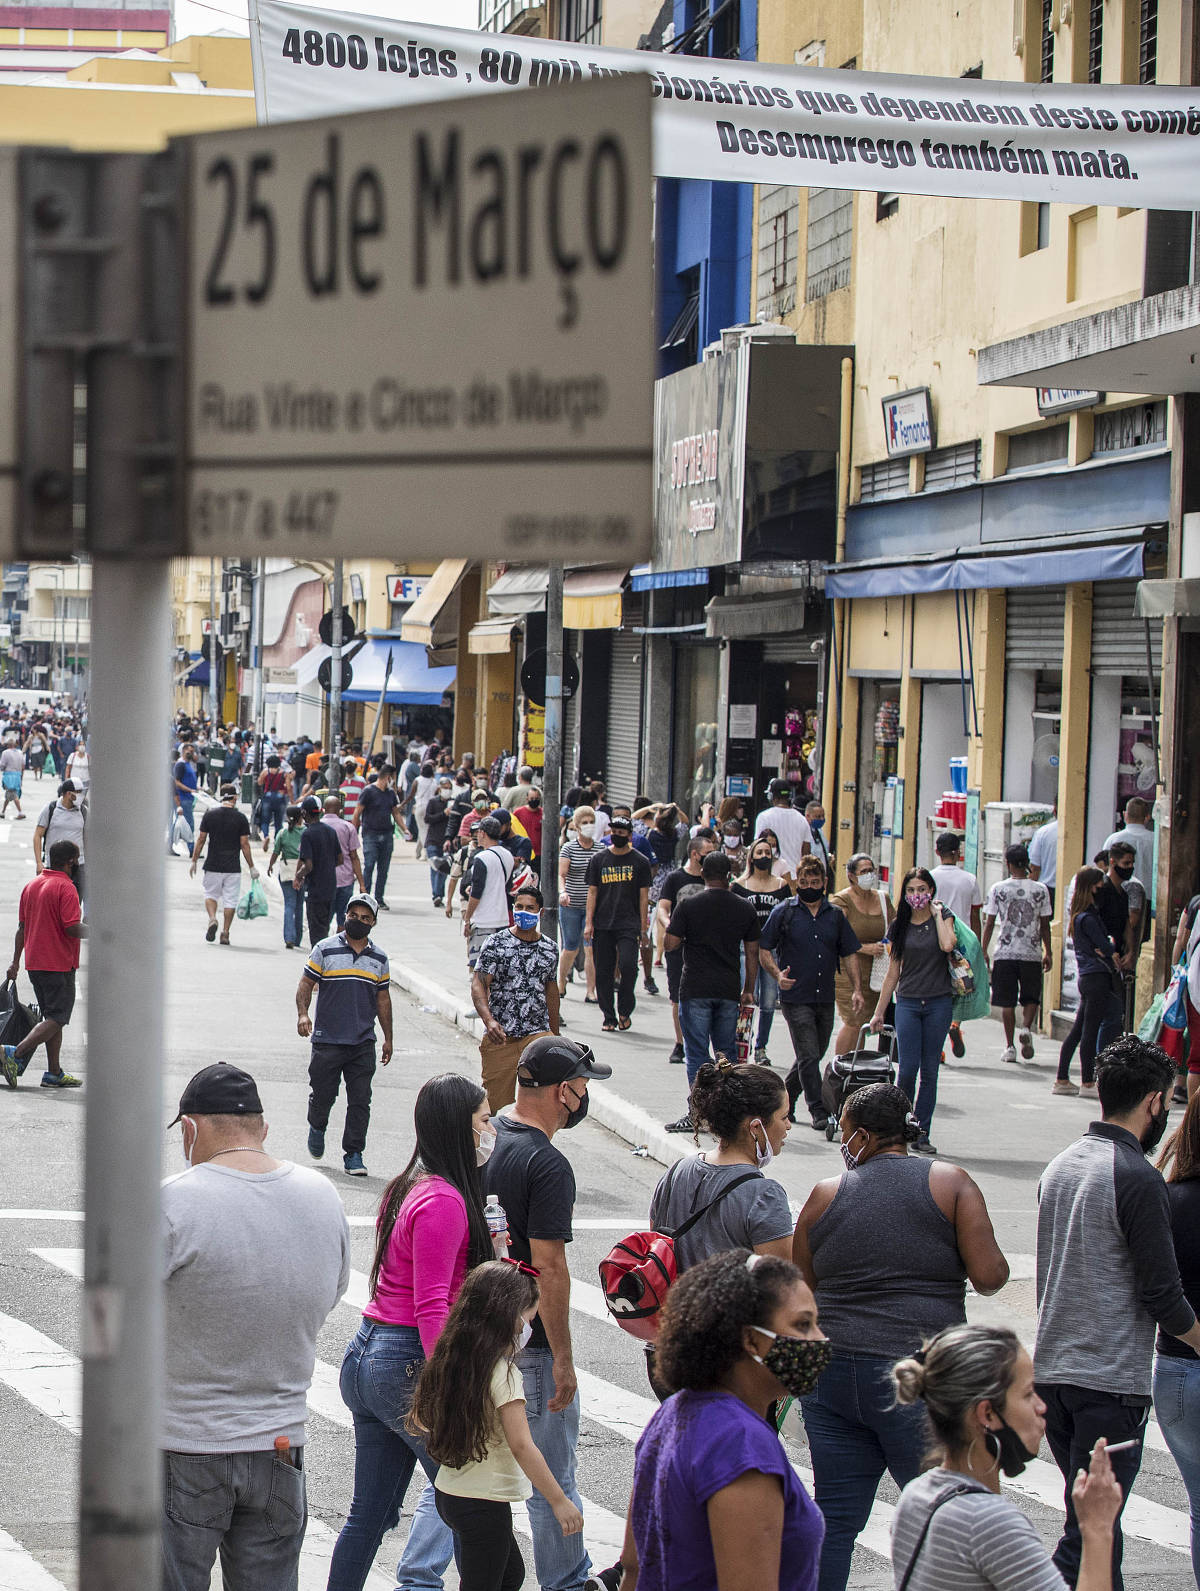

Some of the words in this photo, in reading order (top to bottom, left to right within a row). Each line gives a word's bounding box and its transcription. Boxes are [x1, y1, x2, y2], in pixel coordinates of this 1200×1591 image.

[282, 28, 368, 70] 4800
[375, 37, 458, 78] lojas
[478, 47, 522, 86] 80
[529, 58, 582, 87] mil
[796, 87, 857, 115] que
[860, 92, 1029, 127] dependem
[1029, 103, 1119, 132] deste
[716, 120, 917, 169] Desemprego
[920, 138, 1049, 176] também
[1052, 149, 1139, 180] mata.
[204, 152, 277, 306] 25
[303, 131, 384, 297] de
[412, 125, 628, 329] Março
[200, 382, 257, 434] Rua
[264, 380, 337, 434] Vinte
[347, 391, 365, 433] e
[372, 377, 455, 431] Cinco
[463, 370, 502, 429] de
[508, 368, 608, 437] Março
[671, 429, 719, 489] SUPREMA
[393, 579, 413, 598] AF
